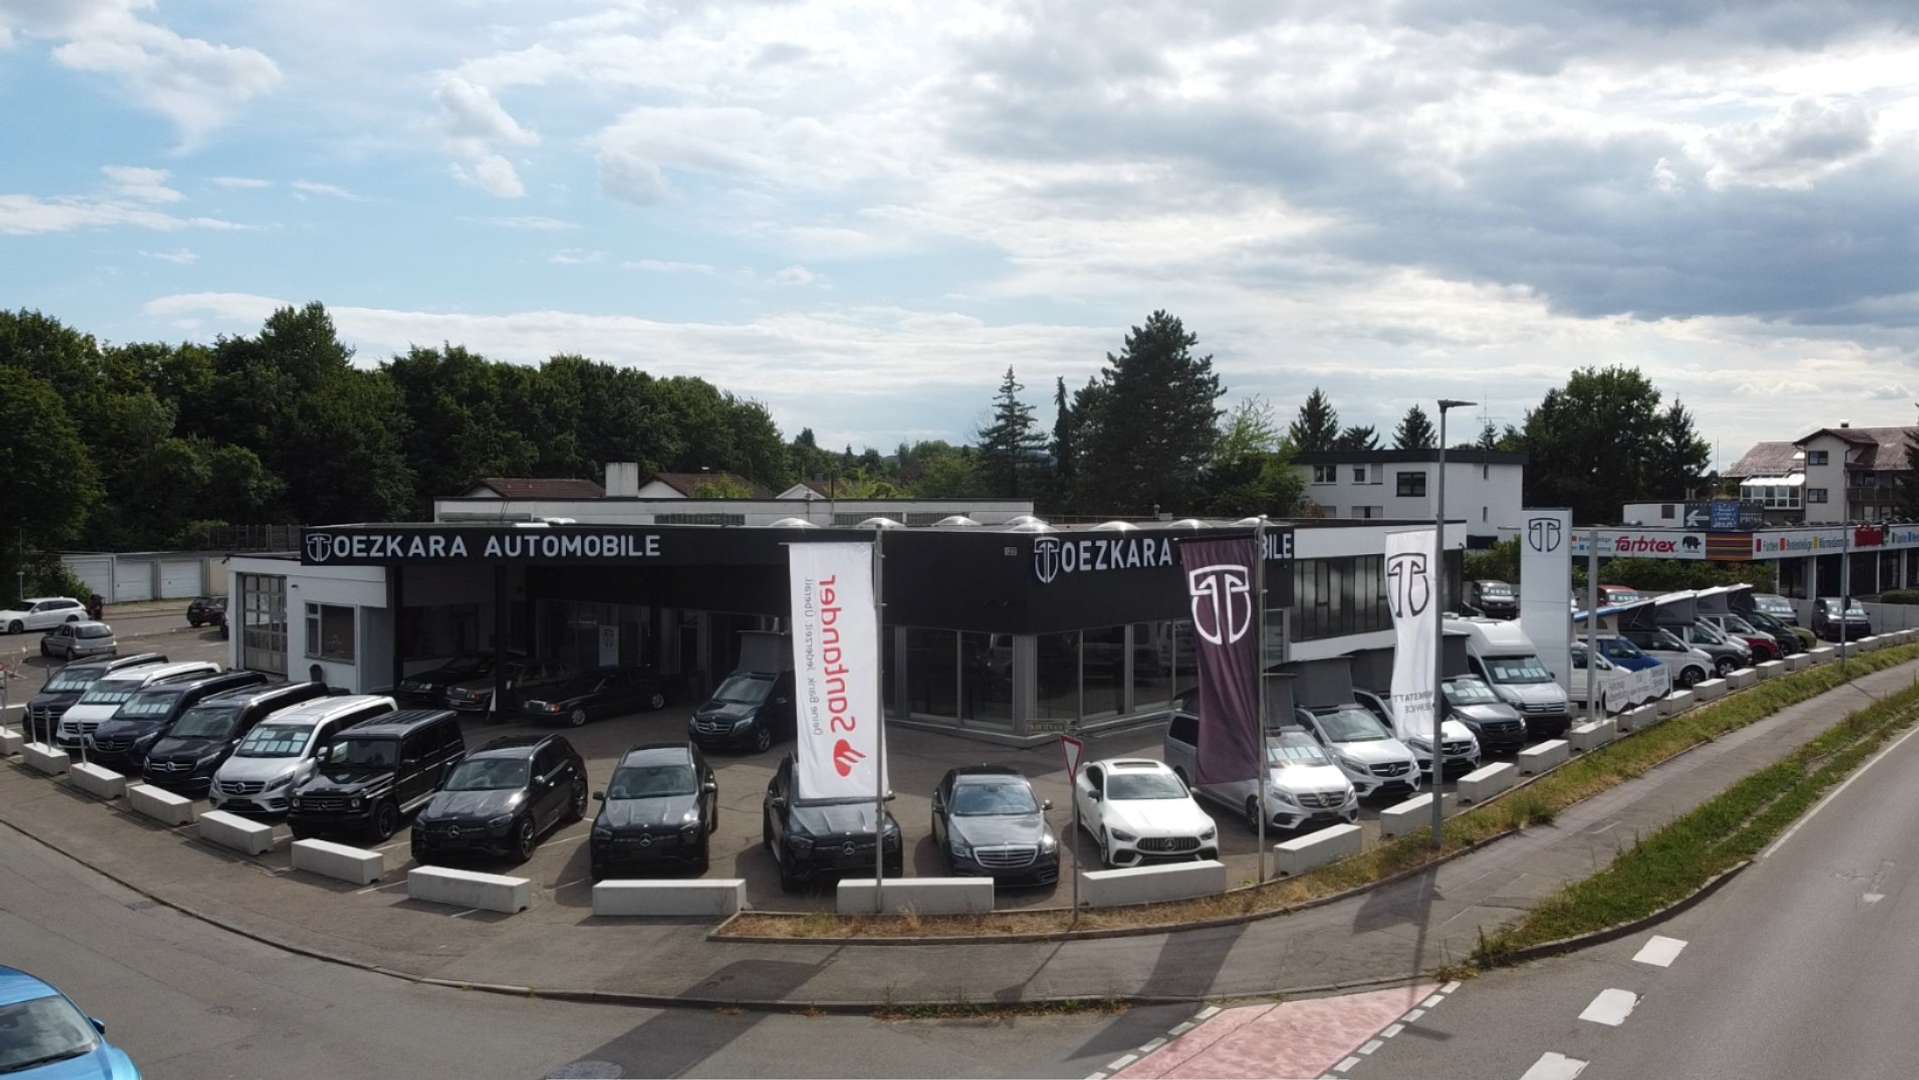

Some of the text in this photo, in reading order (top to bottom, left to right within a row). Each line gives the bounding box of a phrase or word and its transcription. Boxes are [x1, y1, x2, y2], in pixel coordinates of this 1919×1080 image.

[334, 534, 661, 557] OEZKARA AUTOMOBILE
[1062, 537, 1173, 573] OEZKARA
[1615, 536, 1677, 553] farbtex
